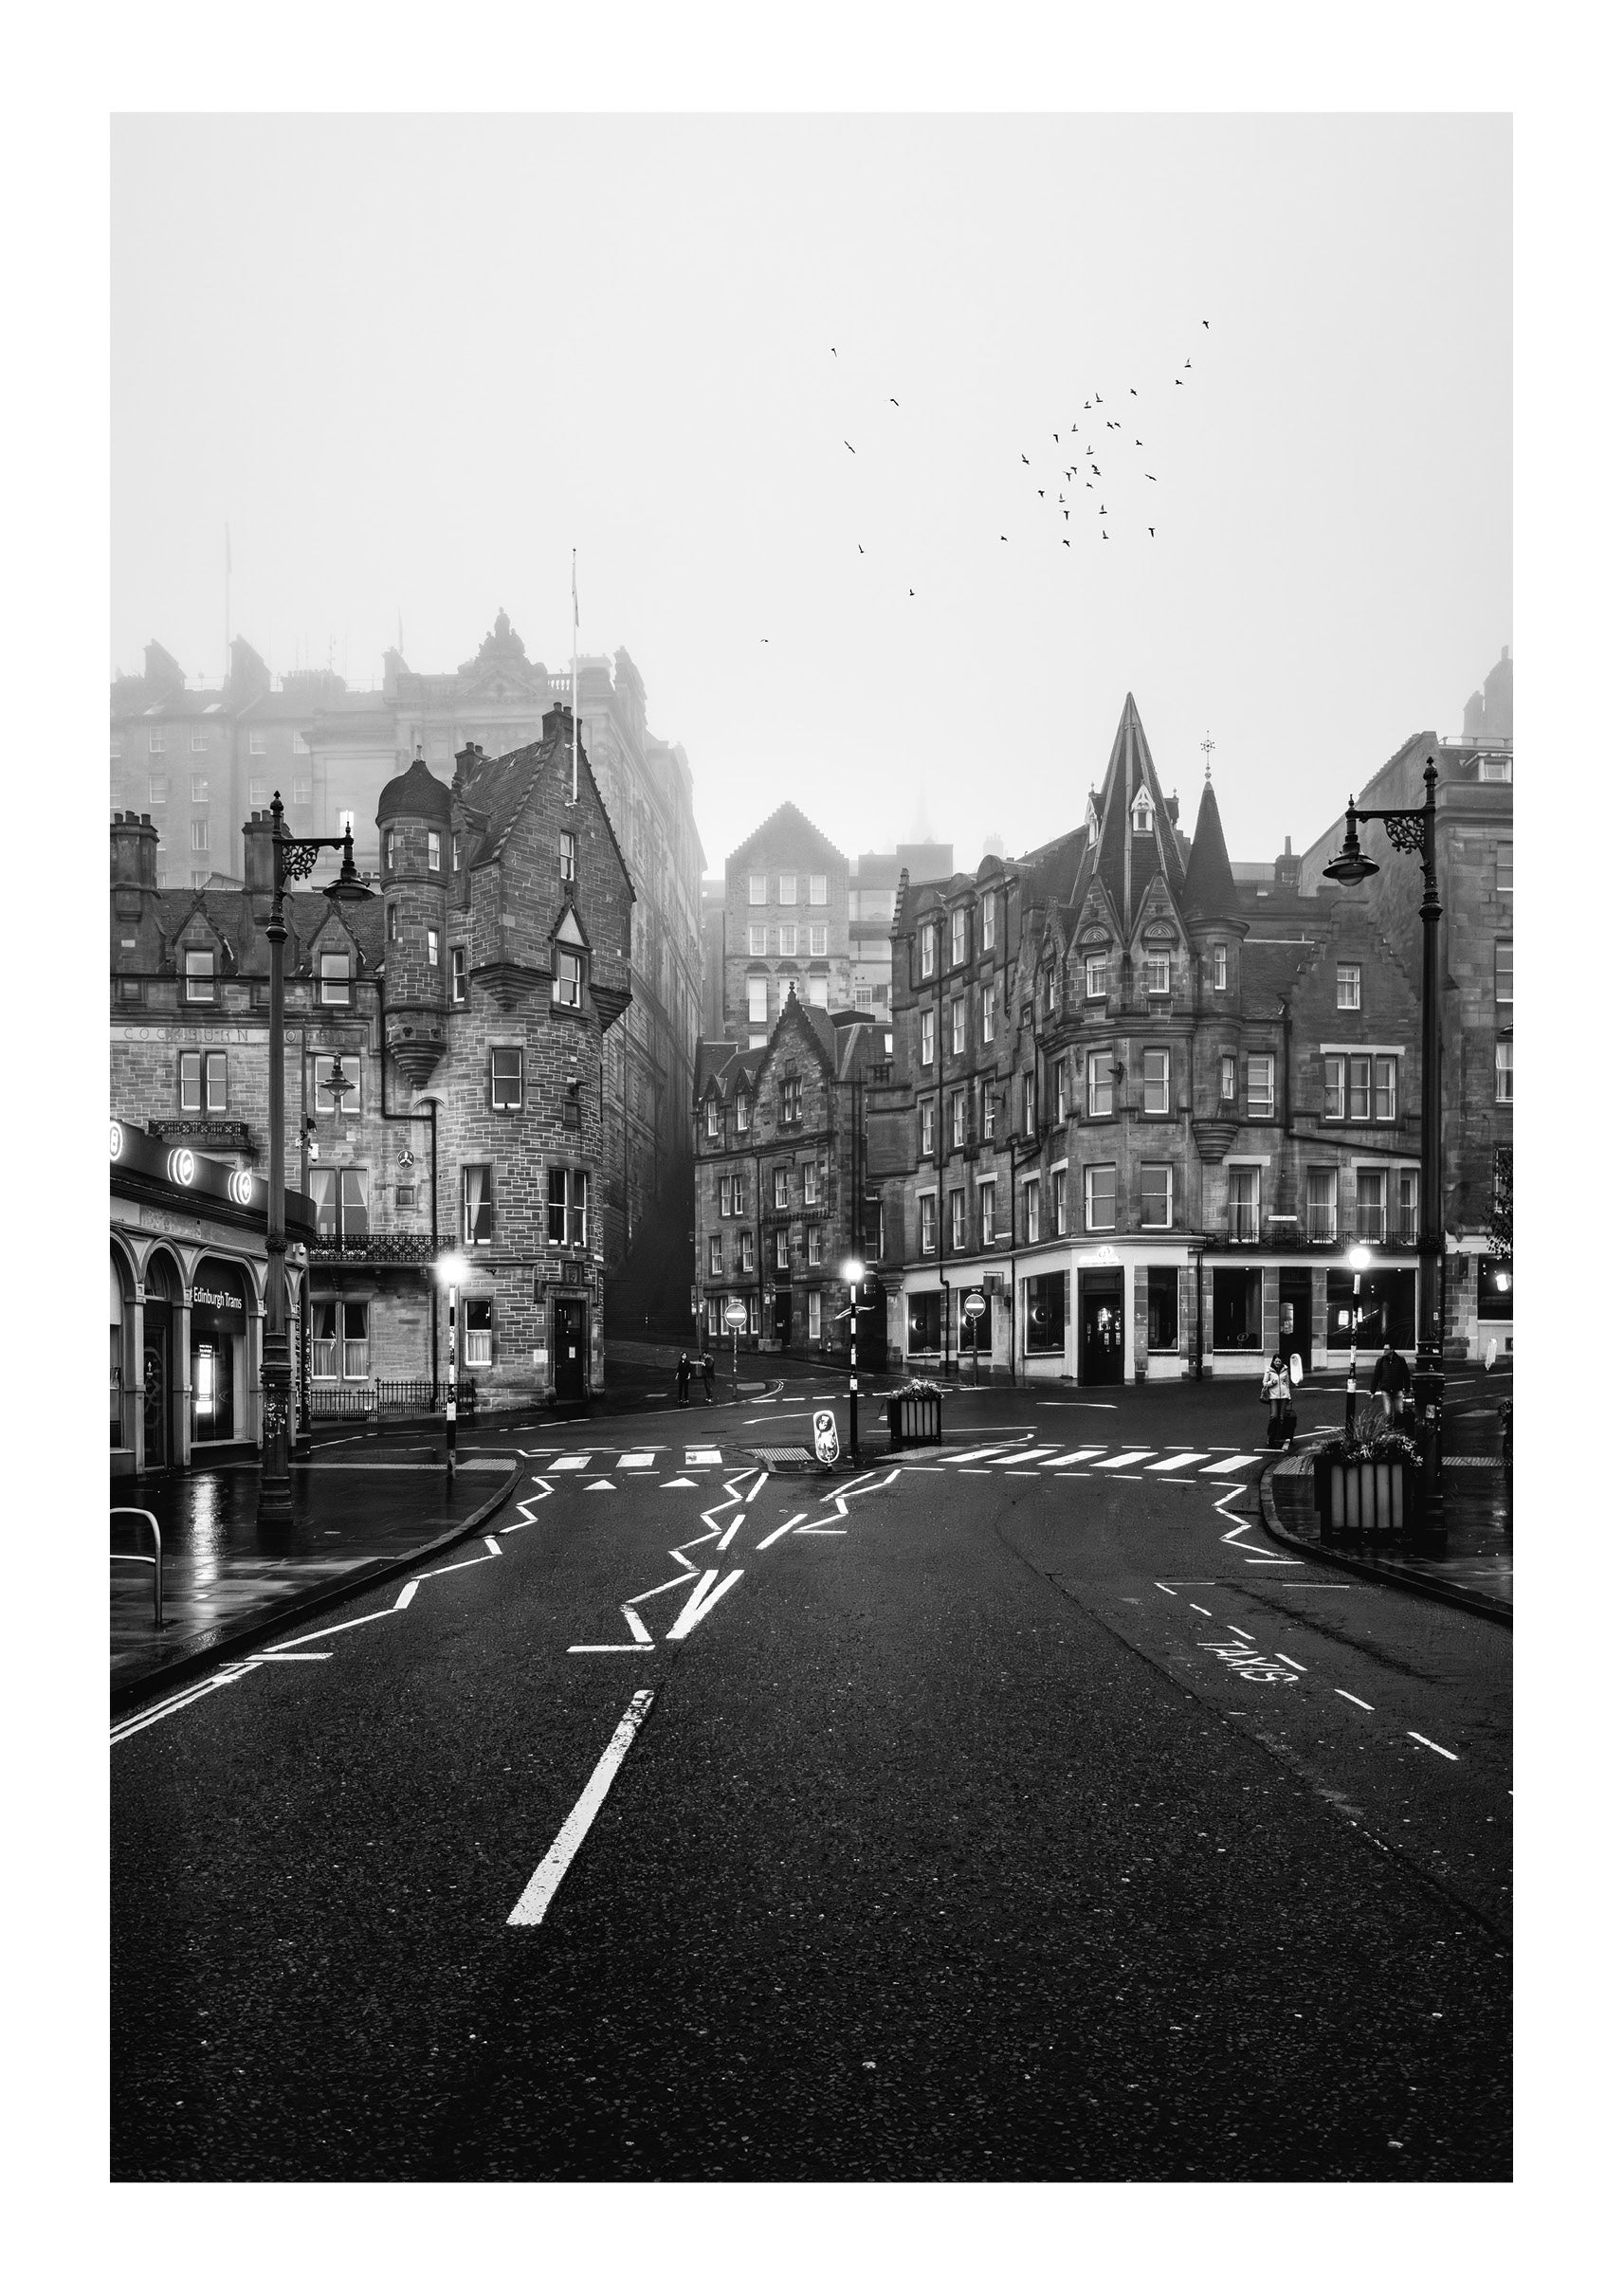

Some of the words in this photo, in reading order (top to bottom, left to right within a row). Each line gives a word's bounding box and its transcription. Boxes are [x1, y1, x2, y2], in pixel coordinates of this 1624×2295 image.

[193, 1286, 225, 1309] Edinburgh
[225, 1292, 242, 1309] Trams
[1196, 1640, 1299, 1682] TAXIS
